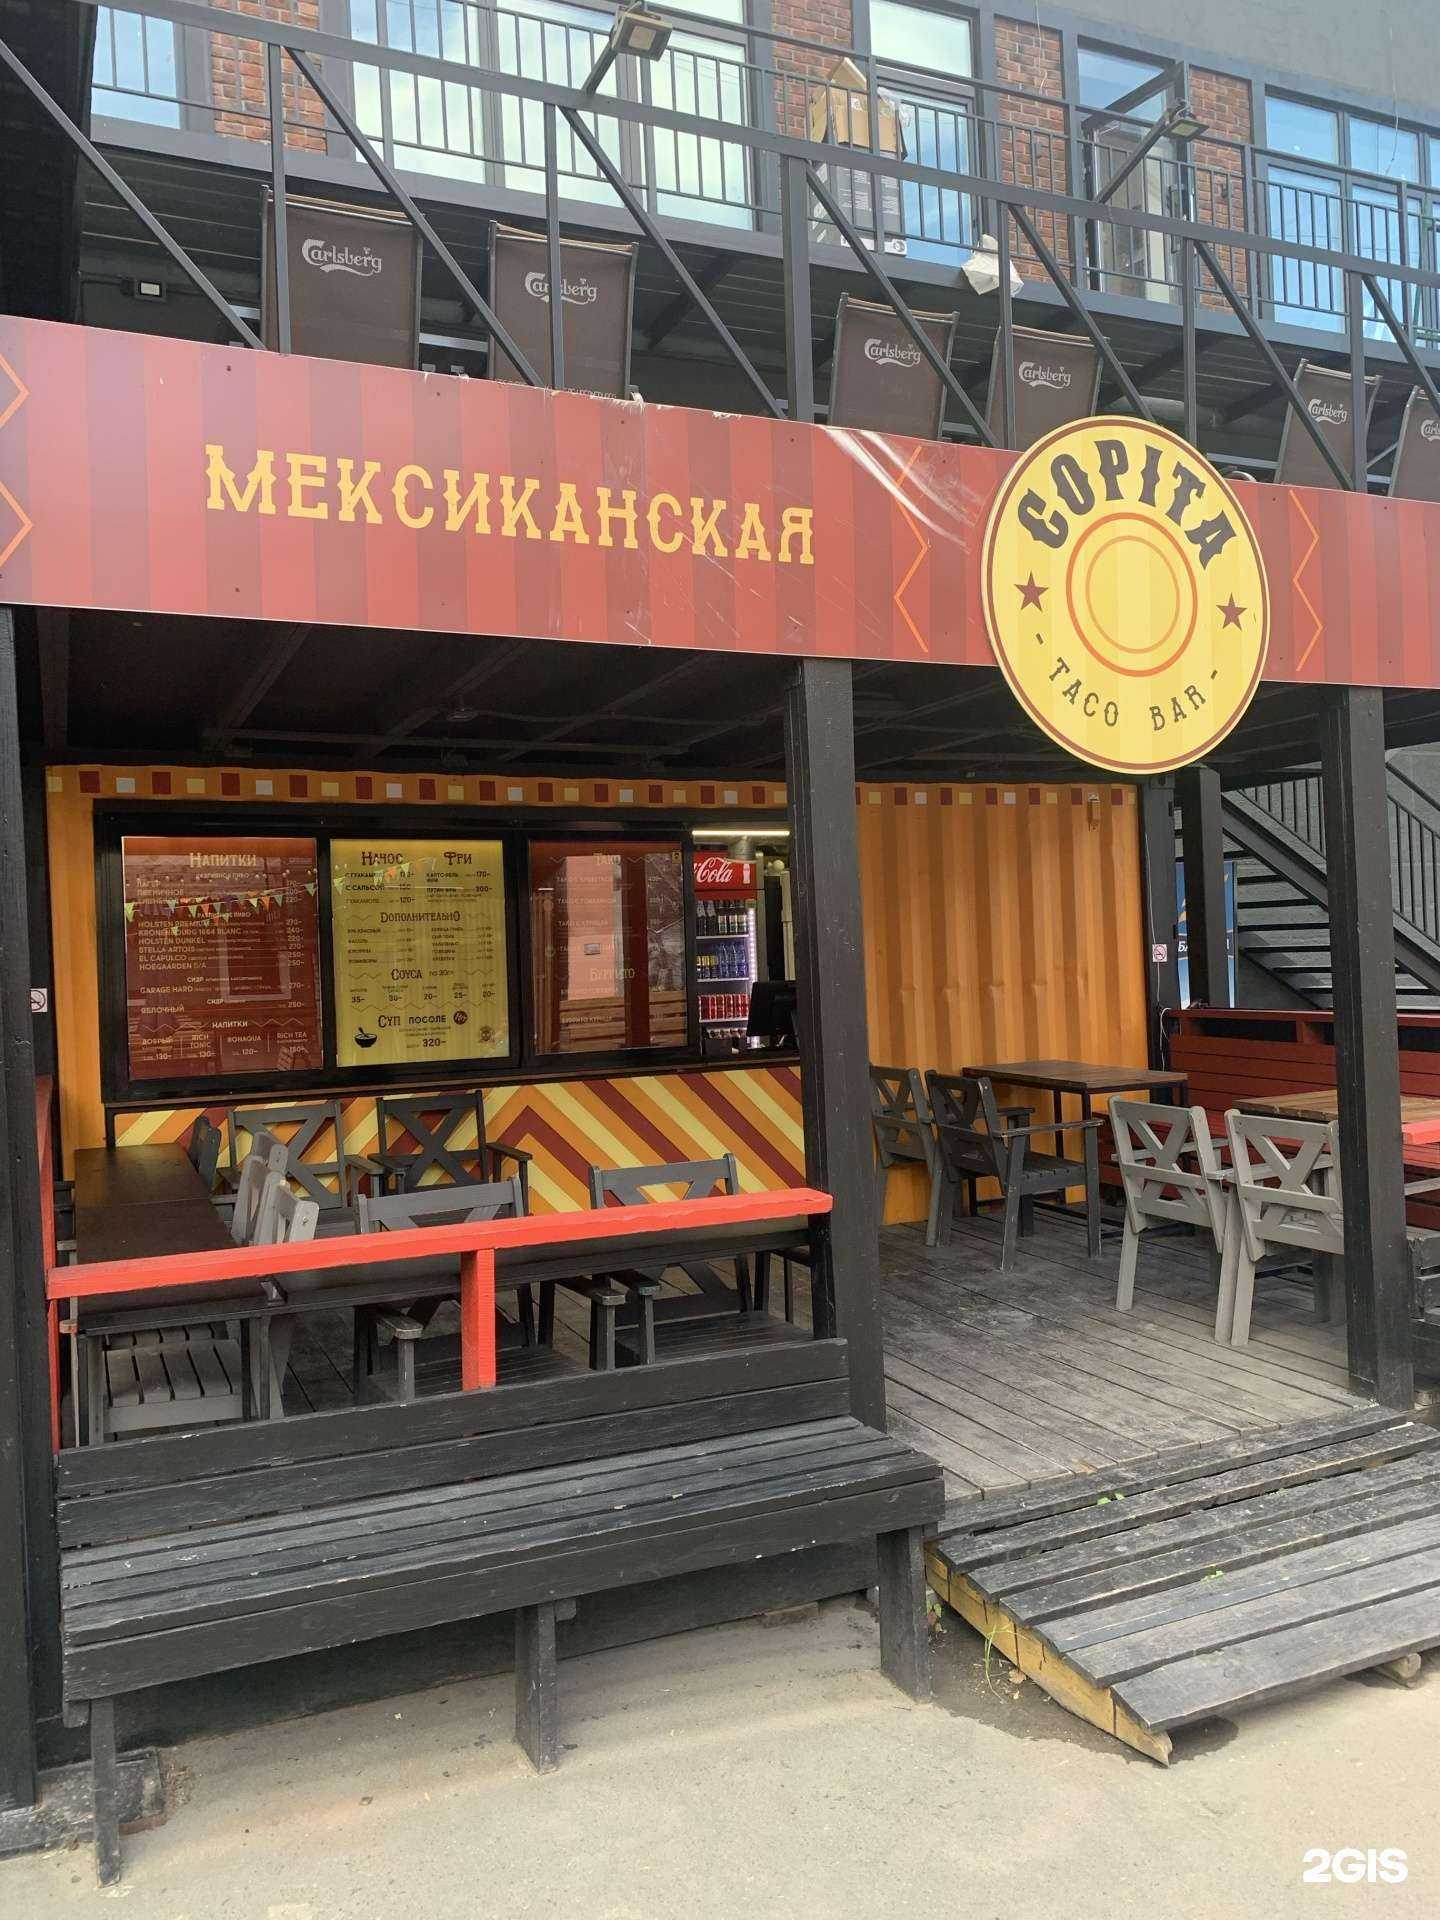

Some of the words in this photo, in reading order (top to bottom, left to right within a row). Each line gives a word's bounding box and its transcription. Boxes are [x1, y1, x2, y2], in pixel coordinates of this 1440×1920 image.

[302, 239, 382, 276] Carlsberg
[525, 271, 598, 305] Carberg
[864, 338, 921, 367] Carlsberg
[1018, 361, 1071, 389] Carlsberg
[1308, 399, 1348, 424] Carlsberg
[205, 444, 815, 565] МЕКСИКАНСКАЯ
[1017, 439, 1238, 570] COPITA
[1048, 656, 1119, 727] TACO
[1149, 684, 1207, 731] BAR
[138, 946, 166, 954] STELLA
[167, 945, 195, 953] ARTOIS
[139, 962, 193, 971] HOEGAARDEN
[140, 986, 171, 994] GARAGE
[172, 985, 194, 993] HARD
[212, 1020, 249, 1029] НАПИТКИ
[408, 1015, 447, 1024] ПОСОЛЕ
